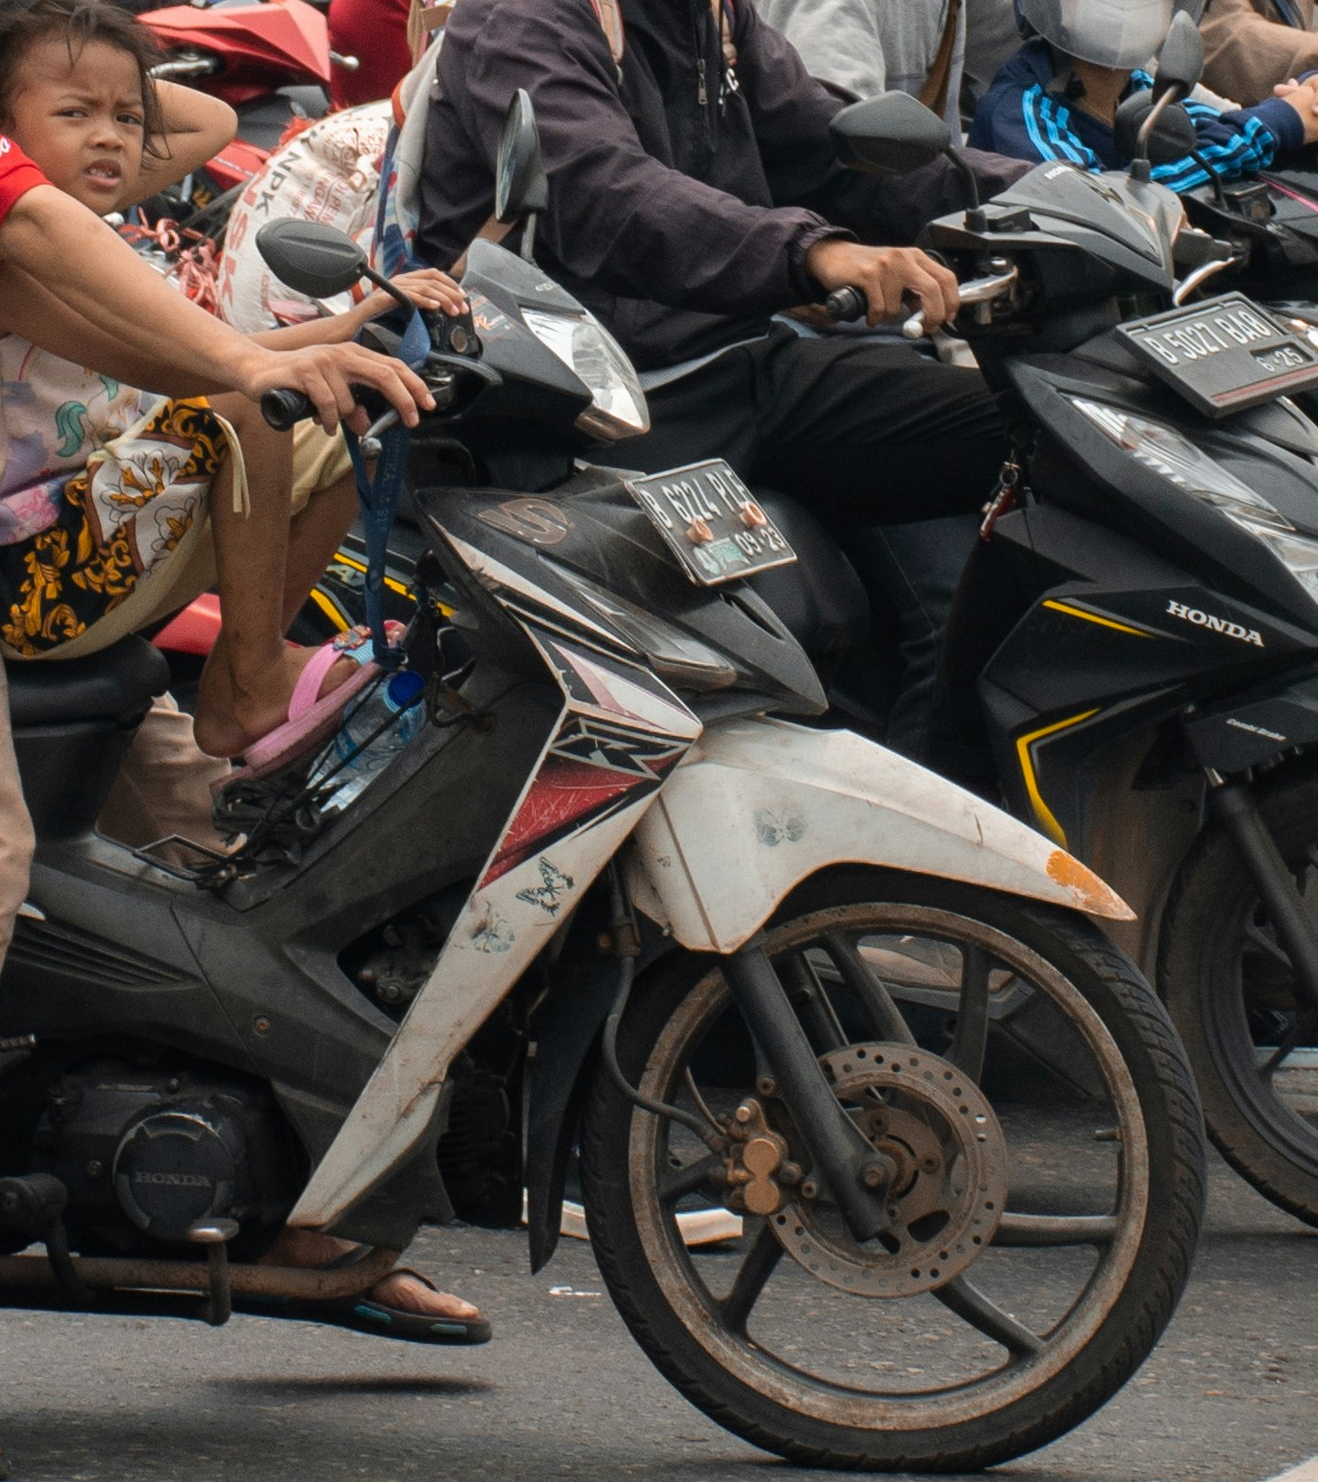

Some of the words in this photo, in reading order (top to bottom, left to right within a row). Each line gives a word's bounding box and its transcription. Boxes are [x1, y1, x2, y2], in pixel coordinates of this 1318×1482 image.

[255, 150, 302, 216] NPK
[1143, 337, 1179, 365] B
[1163, 322, 1229, 360] 5027
[640, 489, 673, 529] B
[662, 478, 722, 524] 6224
[1166, 600, 1265, 647] HONDA
[135, 1171, 213, 1188] HONDA
